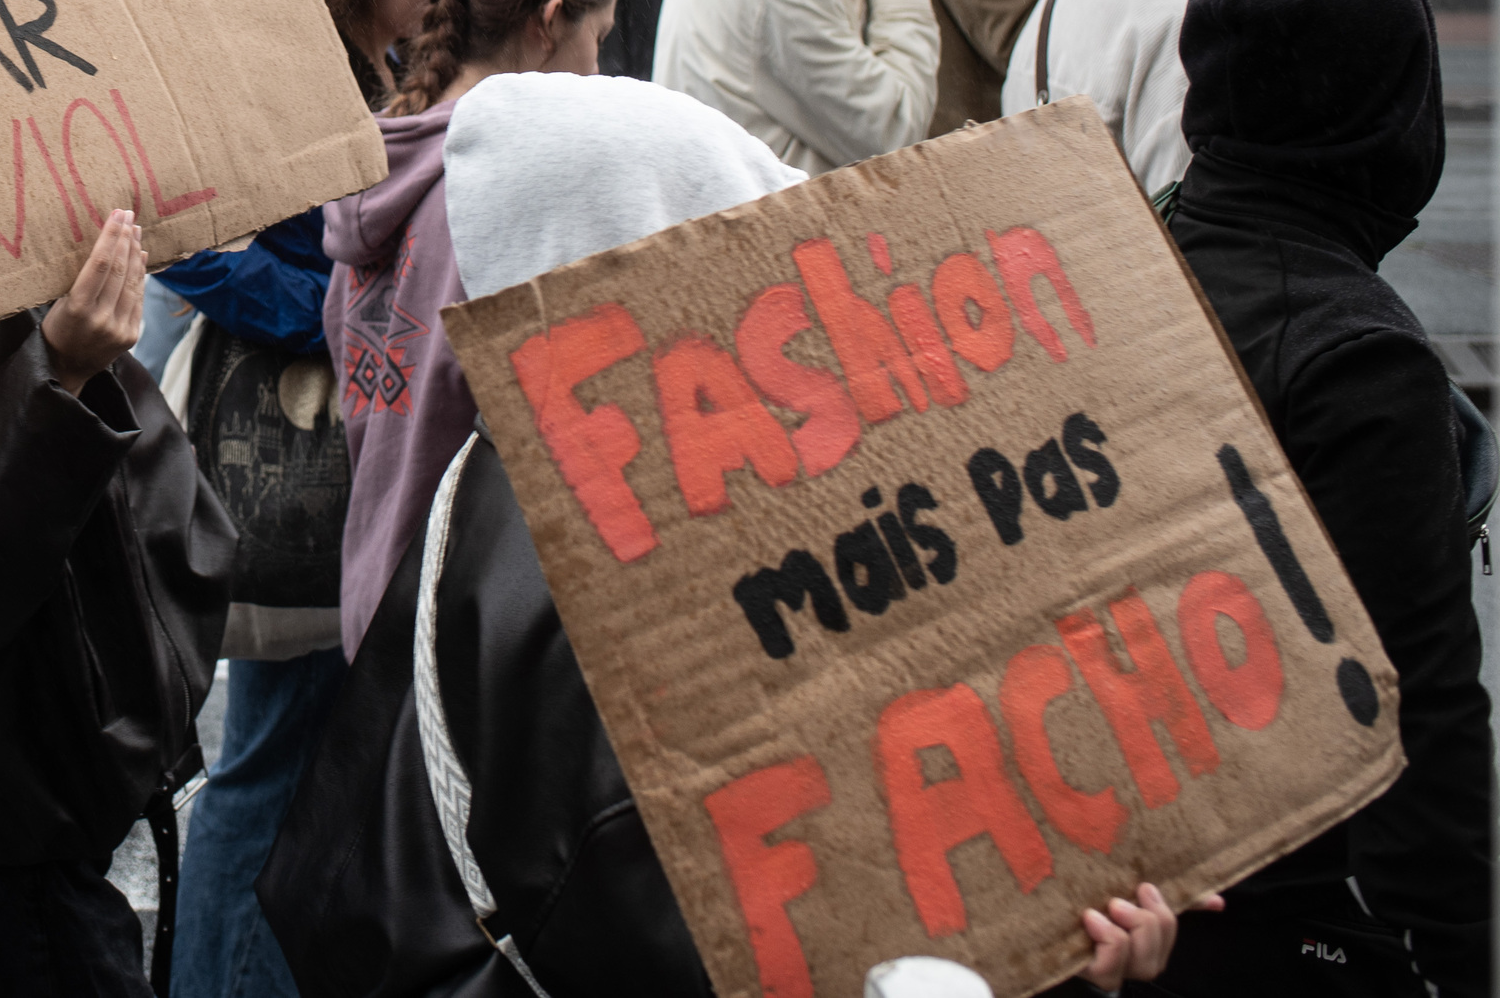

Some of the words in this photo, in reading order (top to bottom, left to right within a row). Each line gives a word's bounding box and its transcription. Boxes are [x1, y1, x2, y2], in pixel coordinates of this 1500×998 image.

[732, 481, 958, 660] mais
[966, 412, 1122, 547] pas
[703, 570, 1284, 998] FACHO
[1300, 938, 1347, 964] FILA
